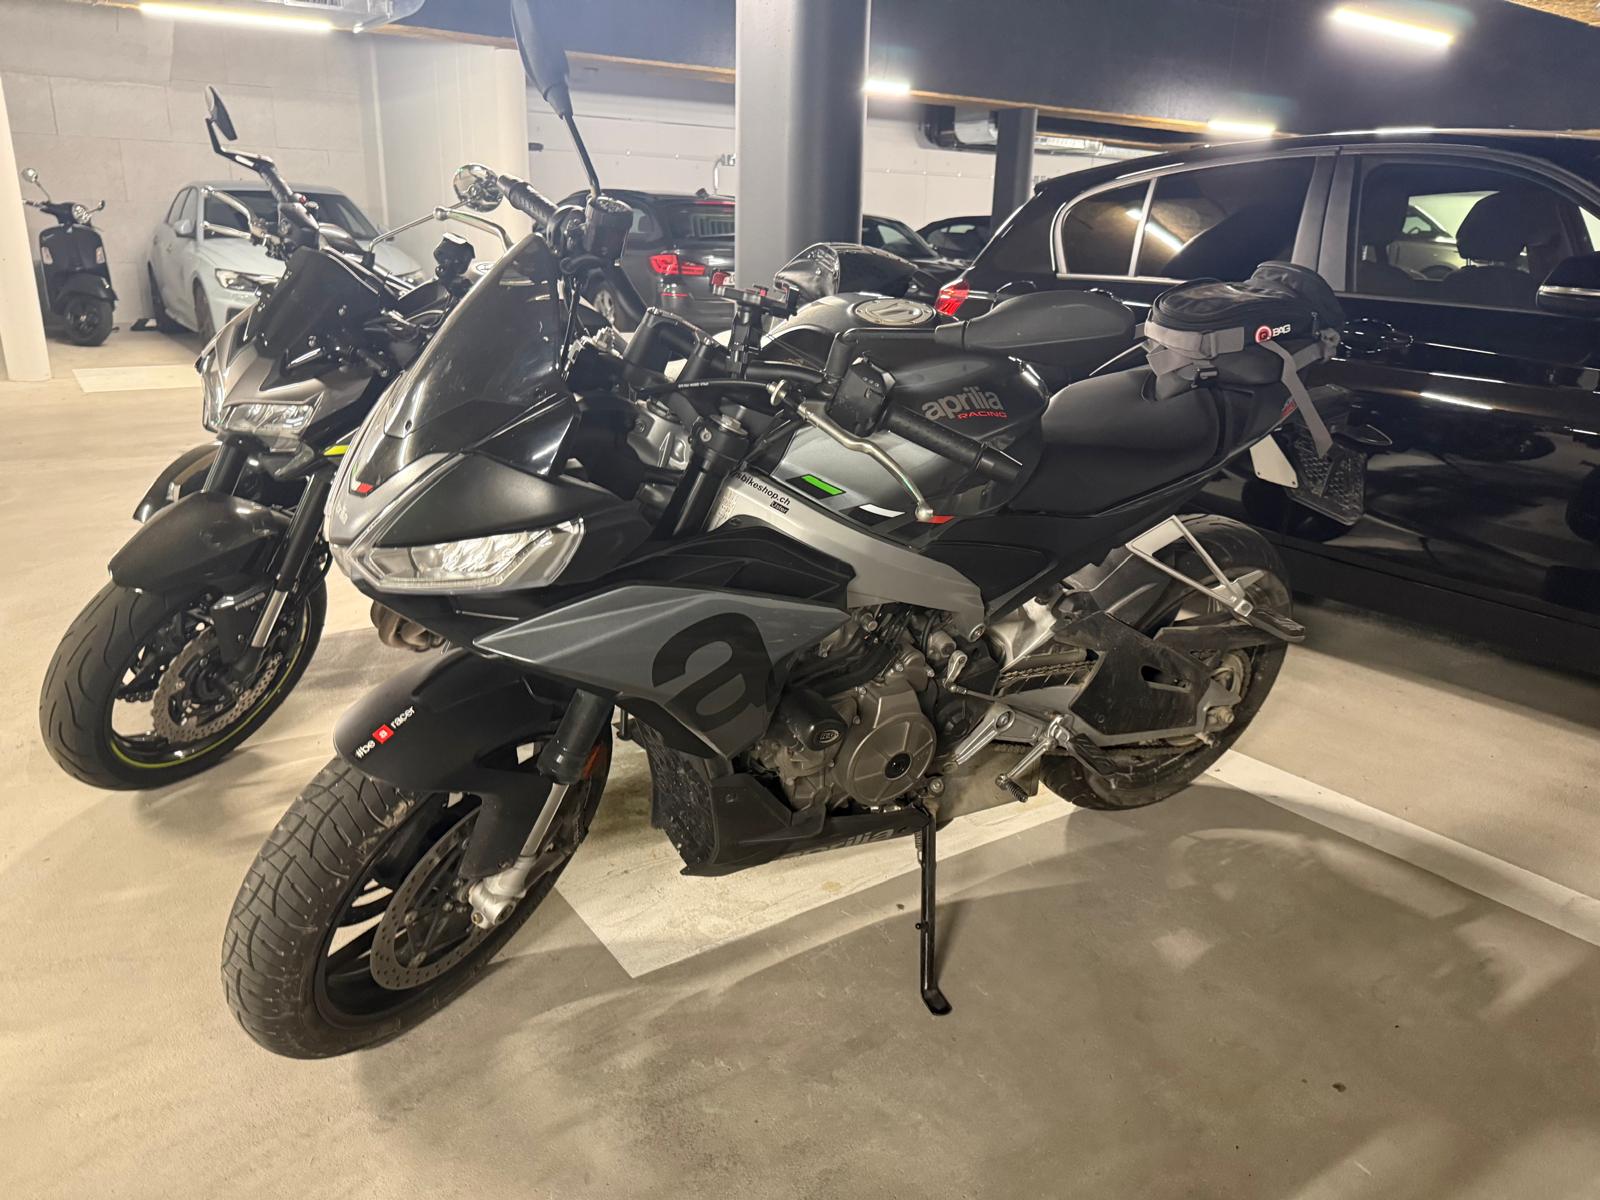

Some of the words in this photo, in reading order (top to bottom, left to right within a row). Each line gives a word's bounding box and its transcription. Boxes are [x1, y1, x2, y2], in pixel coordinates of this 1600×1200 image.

[921, 386, 1004, 420] aprilia
[957, 411, 1008, 419] RACING
[390, 705, 415, 729] racer
